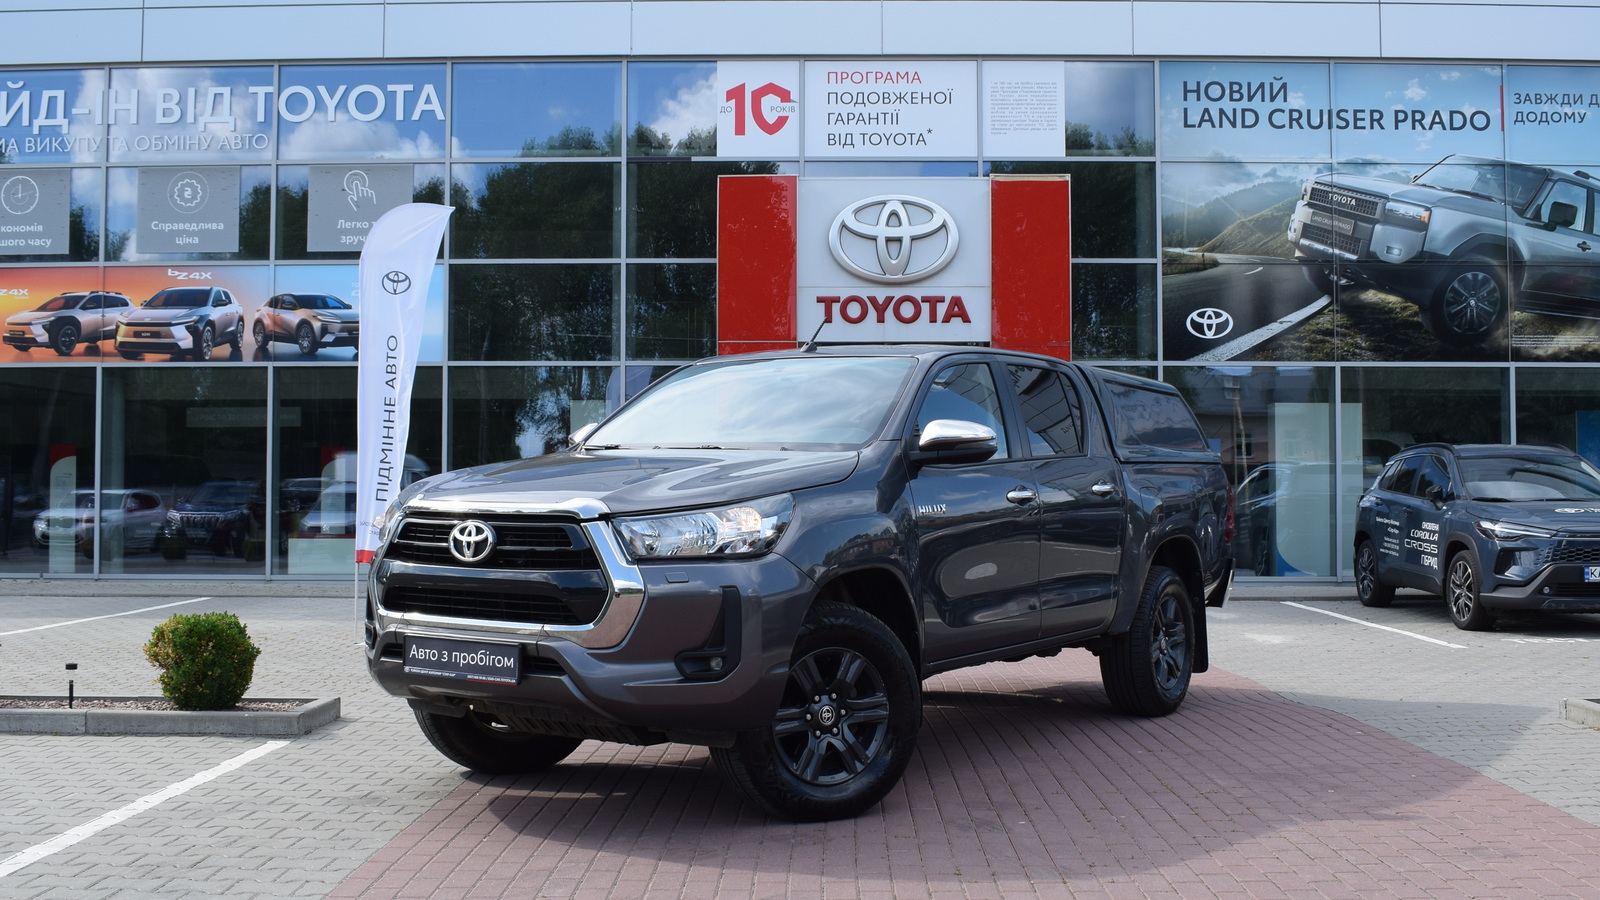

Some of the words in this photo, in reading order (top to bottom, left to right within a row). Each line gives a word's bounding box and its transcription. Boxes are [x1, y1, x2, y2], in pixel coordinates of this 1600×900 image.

[827, 71, 922, 85] ПРОГРАМА
[1182, 76, 1288, 103] НОВИЙ
[827, 88, 954, 108] ПОДОВЖЕНОЇ
[1513, 92, 1585, 108] ЗАВЖДИ
[156, 86, 236, 132] ВІД
[248, 83, 446, 124] TOYOTA
[719, 105, 732, 114] ДО
[770, 105, 796, 114] РОКІВ
[827, 110, 900, 126] ГАРАНТІЇ
[1183, 108, 1260, 129] LAND
[1268, 108, 1385, 131] CRUISER
[1394, 110, 1491, 132] PRADO
[1513, 111, 1587, 125] ДОДОМУ
[25, 137, 102, 153] ВИКУПУ
[107, 136, 130, 151] ТА
[135, 135, 214, 152] ОБМІНУ
[218, 133, 269, 151] АВТО
[827, 133, 855, 148] ВІД
[1328, 193, 1356, 206] TOYOTA
[151, 221, 224, 232] Справедлива
[337, 220, 369, 229] Легко
[28, 238, 52, 248] часу
[175, 234, 199, 246] ціна
[340, 235, 368, 245] зруч
[816, 295, 971, 324] TOYOTA
[385, 335, 398, 389] АВТО
[375, 397, 397, 502] ПІДМІННЕ
[918, 503, 946, 513] HILUX
[1410, 529, 1439, 541] COROLLA
[1404, 538, 1438, 554] CROSS
[409, 644, 438, 661] Авто
[441, 650, 449, 662] з
[452, 650, 514, 668] пробігом
